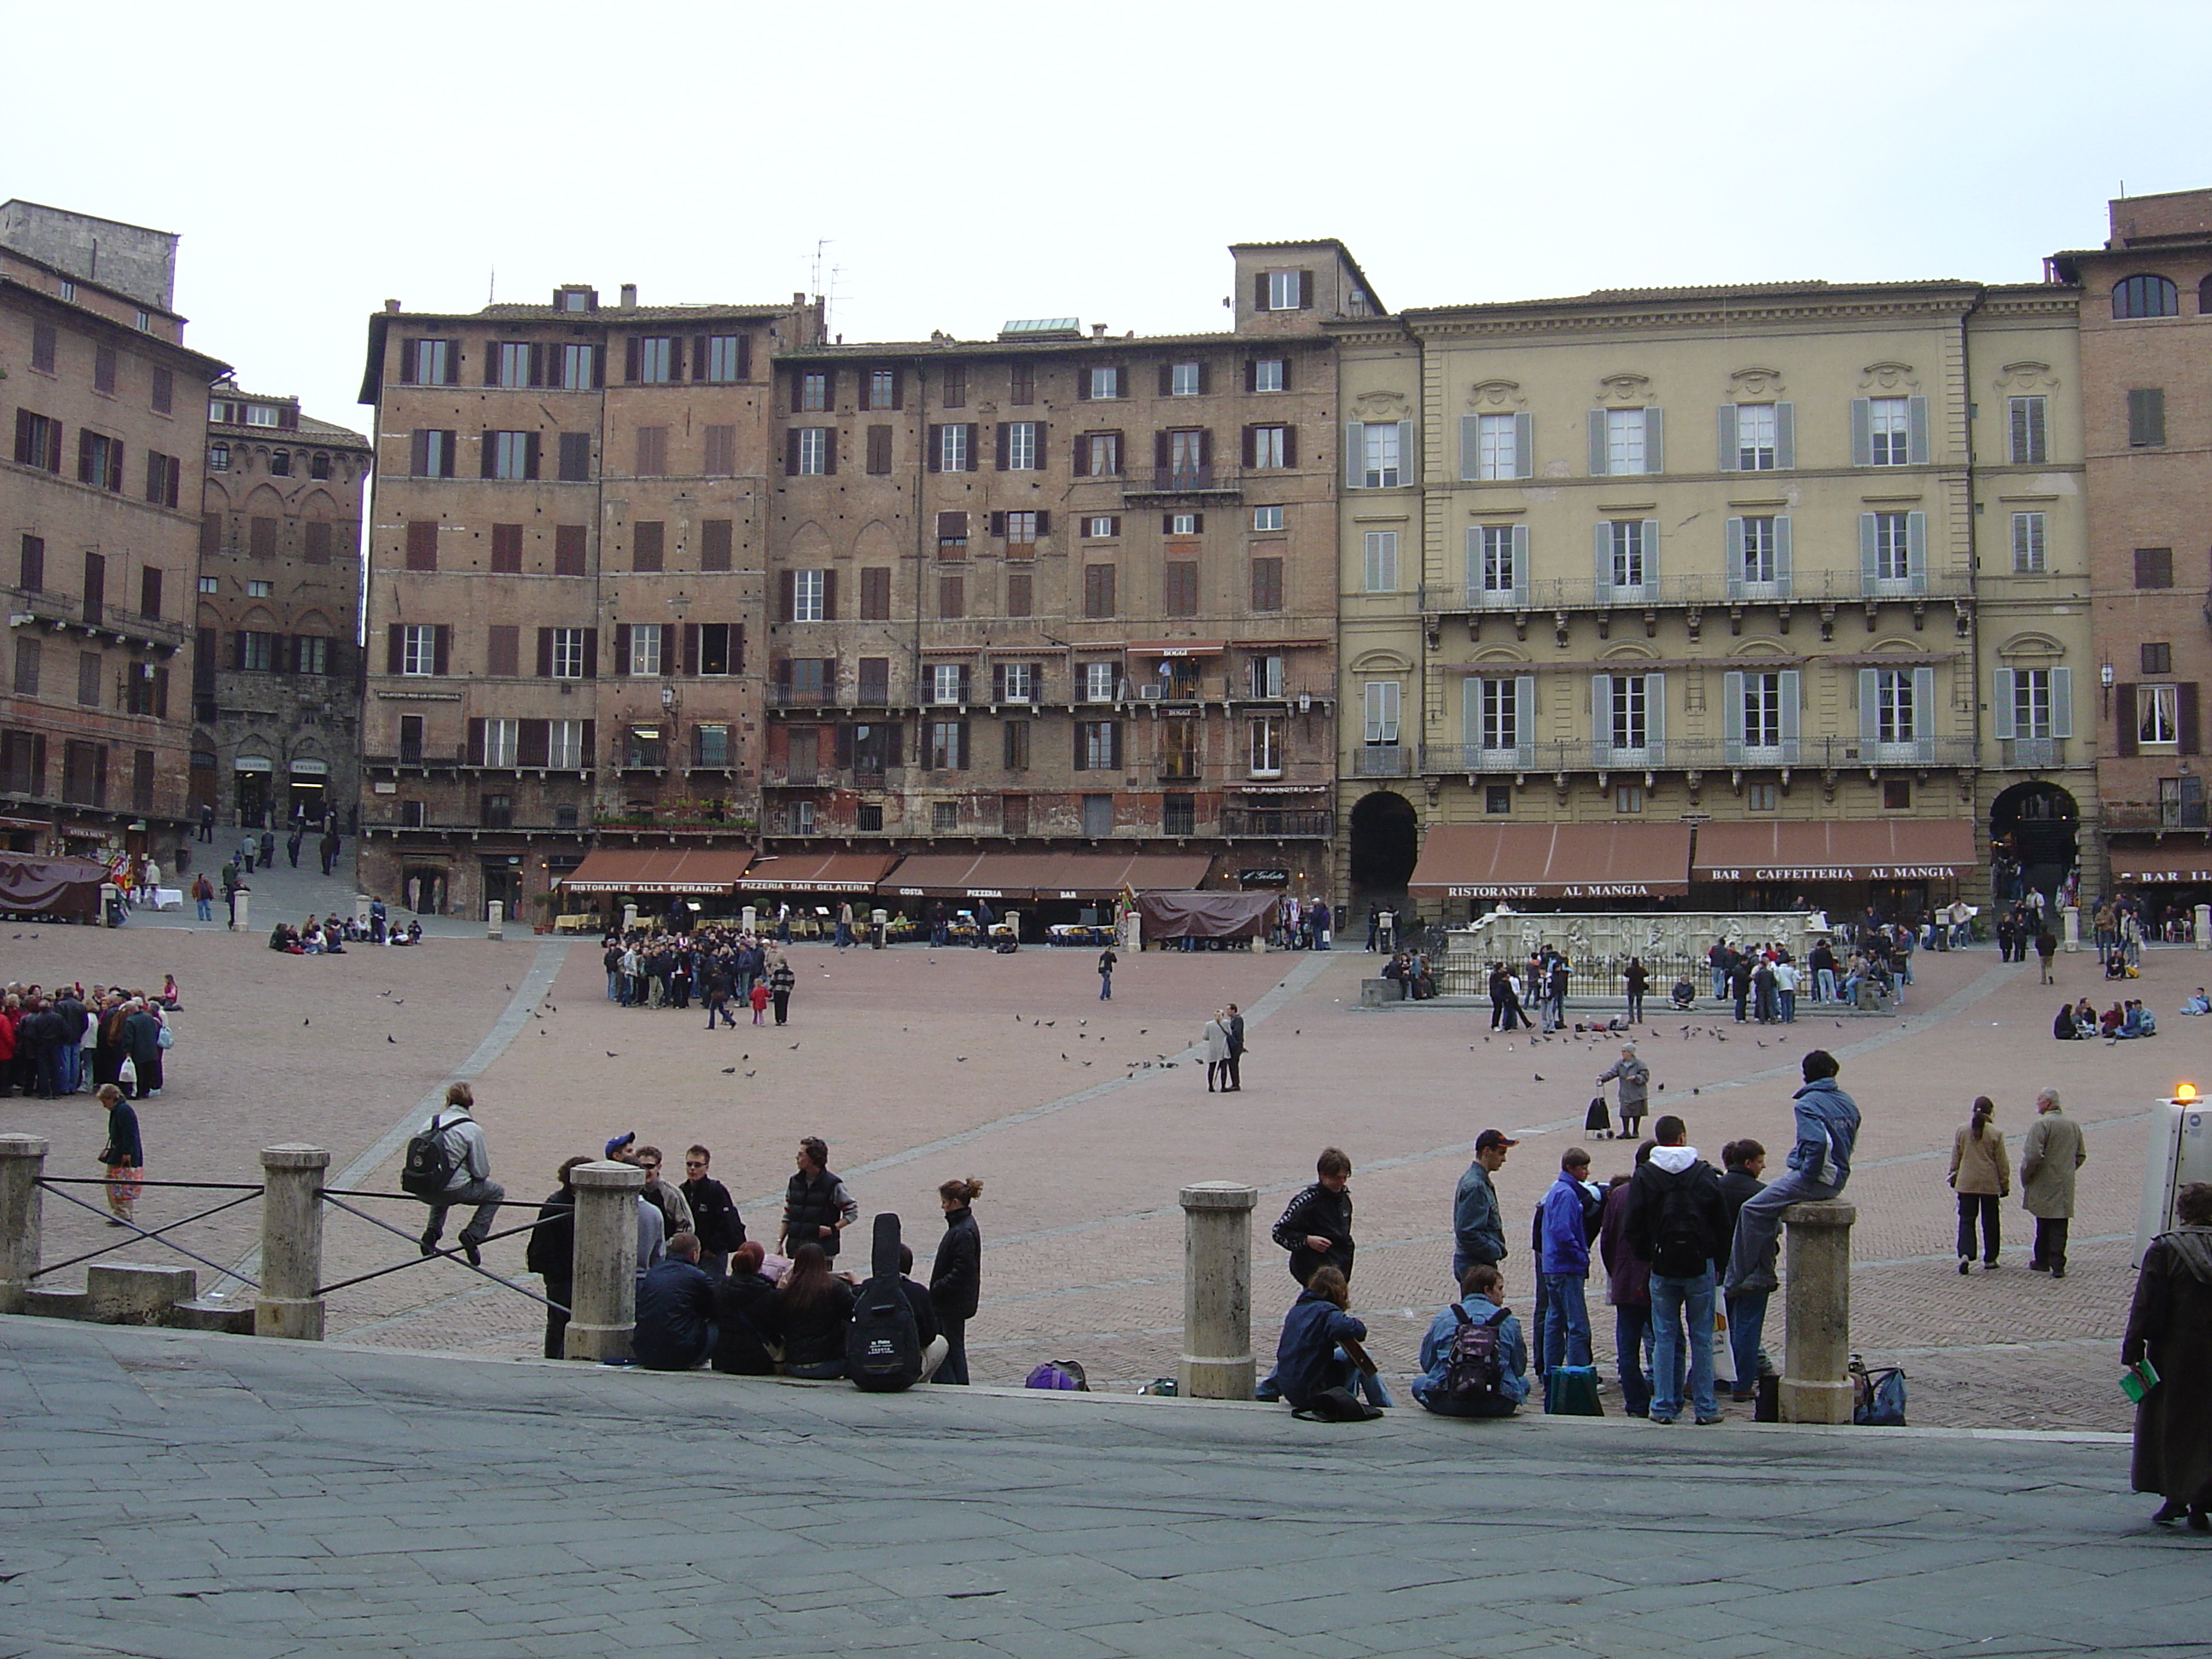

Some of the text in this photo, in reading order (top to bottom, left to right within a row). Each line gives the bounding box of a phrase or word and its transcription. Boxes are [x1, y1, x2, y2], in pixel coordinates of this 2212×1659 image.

[1712, 867, 1954, 880] BAR CAFFETTERIA AL MANGIA
[2141, 871, 2212, 882] BAR IL
[670, 885, 724, 894] SPERANZA
[817, 883, 870, 892] GELATERIA
[1448, 885, 1648, 897] RISTORANTE AL MANGIA
